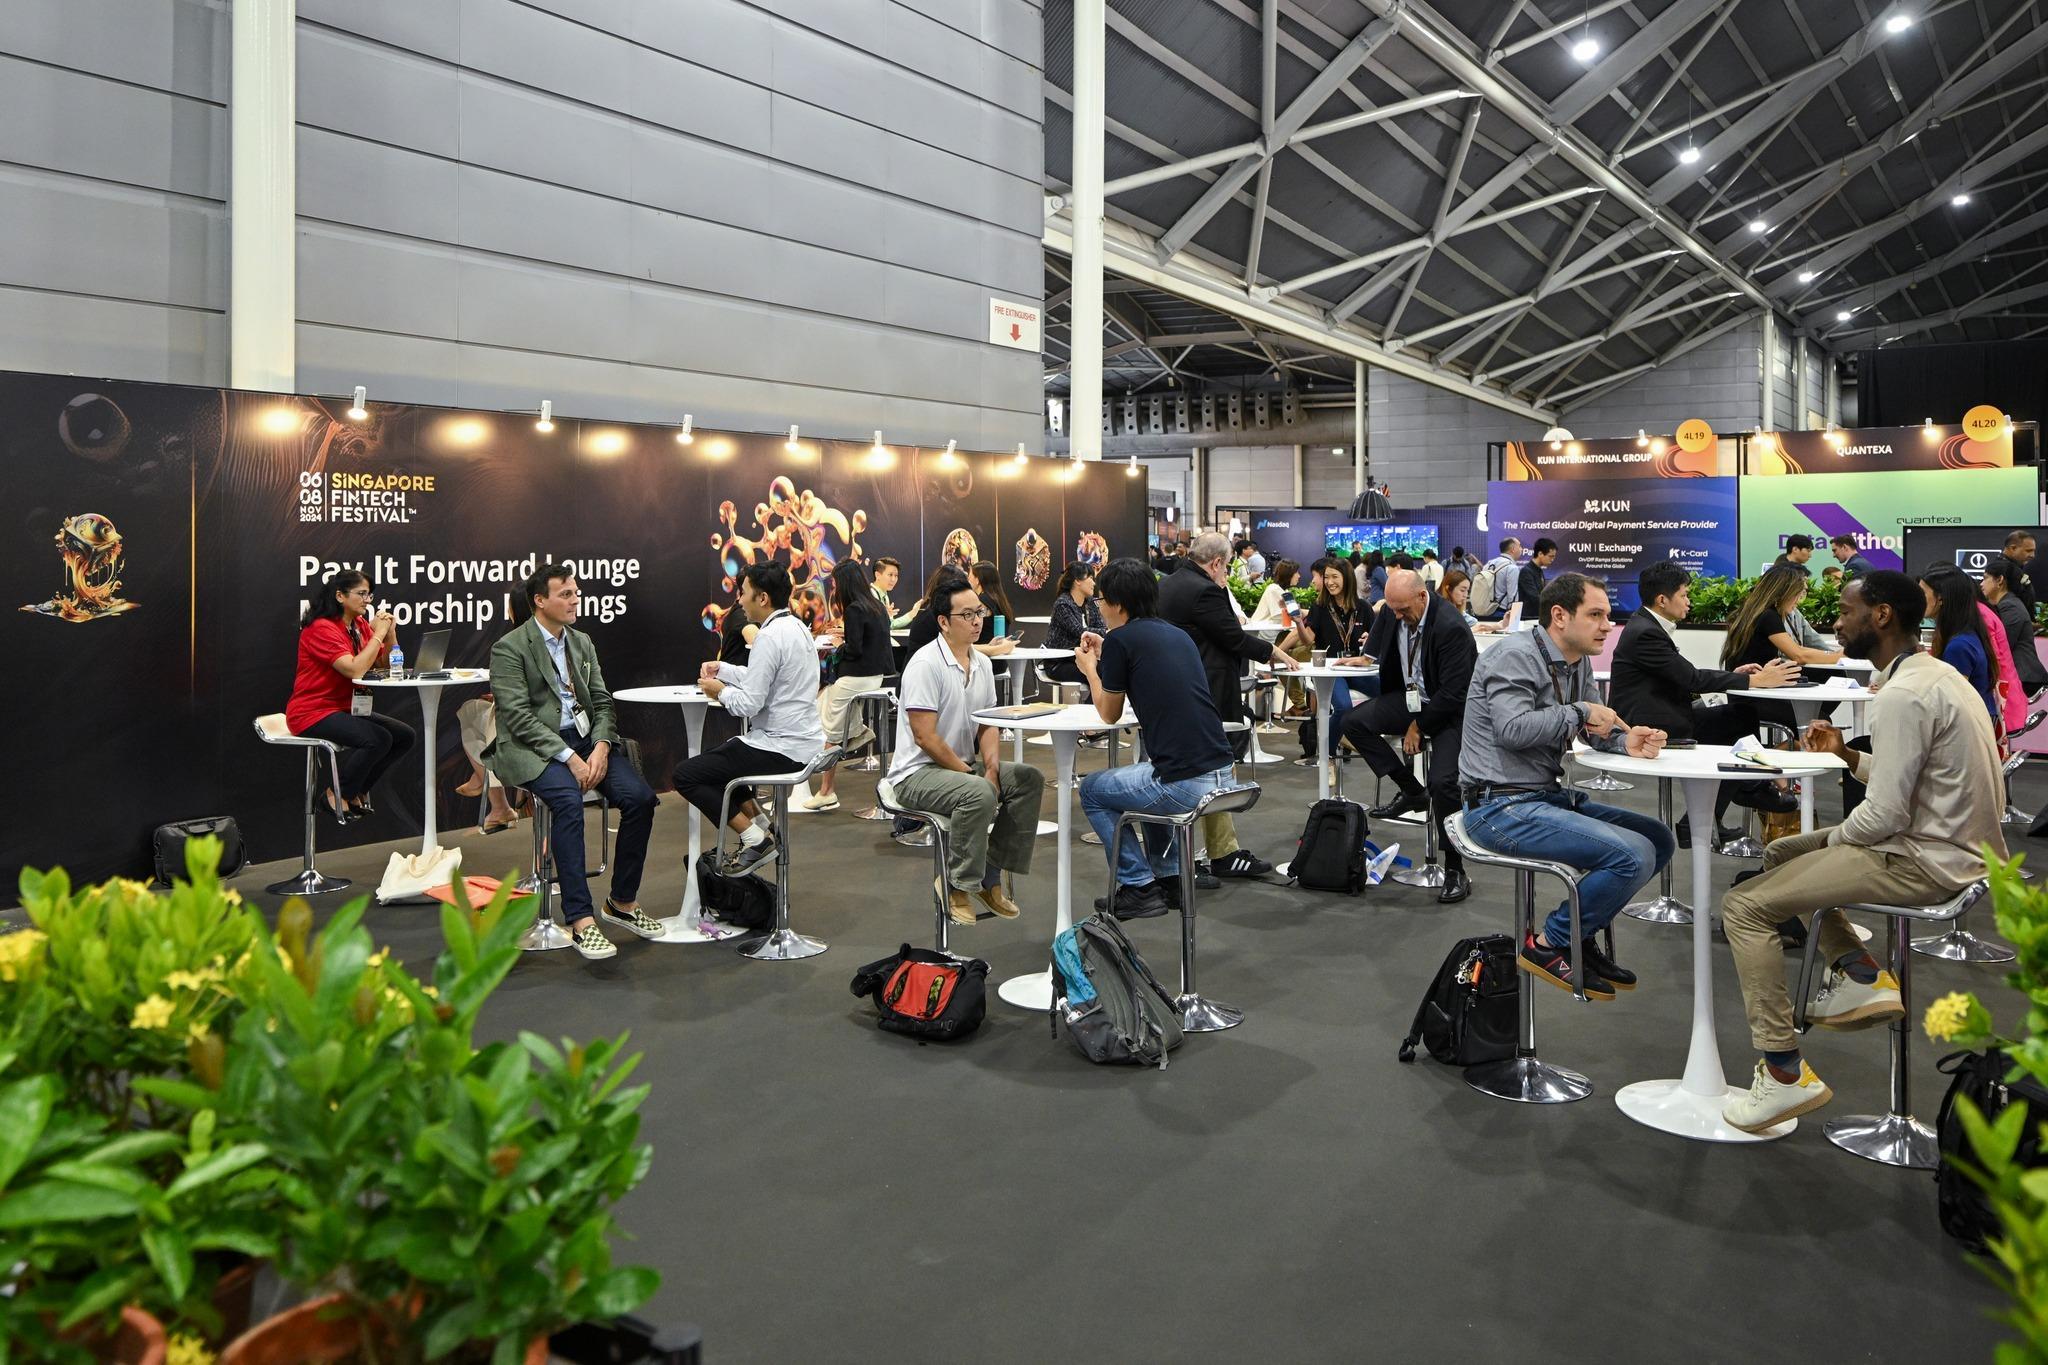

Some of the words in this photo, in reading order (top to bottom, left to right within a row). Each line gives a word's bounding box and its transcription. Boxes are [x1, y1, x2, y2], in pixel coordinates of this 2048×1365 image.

[1972, 419, 1997, 429] 4L20
[1684, 432, 1705, 440] 4L19
[1836, 445, 1893, 456] QUANTEXA
[1537, 456, 1555, 464] KUN
[1556, 454, 1621, 464] INTERNATIONAL
[1622, 453, 1653, 462] GROUP
[300, 471, 322, 488] 06
[331, 472, 435, 492] SINGAPORE
[300, 489, 322, 505] 08
[331, 490, 406, 507] FINTECH
[300, 506, 322, 514] NOV
[1601, 500, 1630, 512] KUN
[300, 514, 322, 522] 2024
[1896, 515, 1962, 525] quantexa
[1503, 521, 1518, 529] The
[1520, 521, 1550, 529] Trusted
[1551, 521, 1577, 529] Global
[1578, 521, 1605, 531] Digital
[1606, 520, 1646, 530] Payment
[1647, 520, 1679, 529] Service
[1680, 520, 1718, 529] Provider
[1569, 543, 1592, 552] KUN
[1598, 543, 1643, 554] Exchange
[374, 554, 399, 585] It
[410, 552, 536, 584] Forward
[546, 553, 640, 587] ounge
